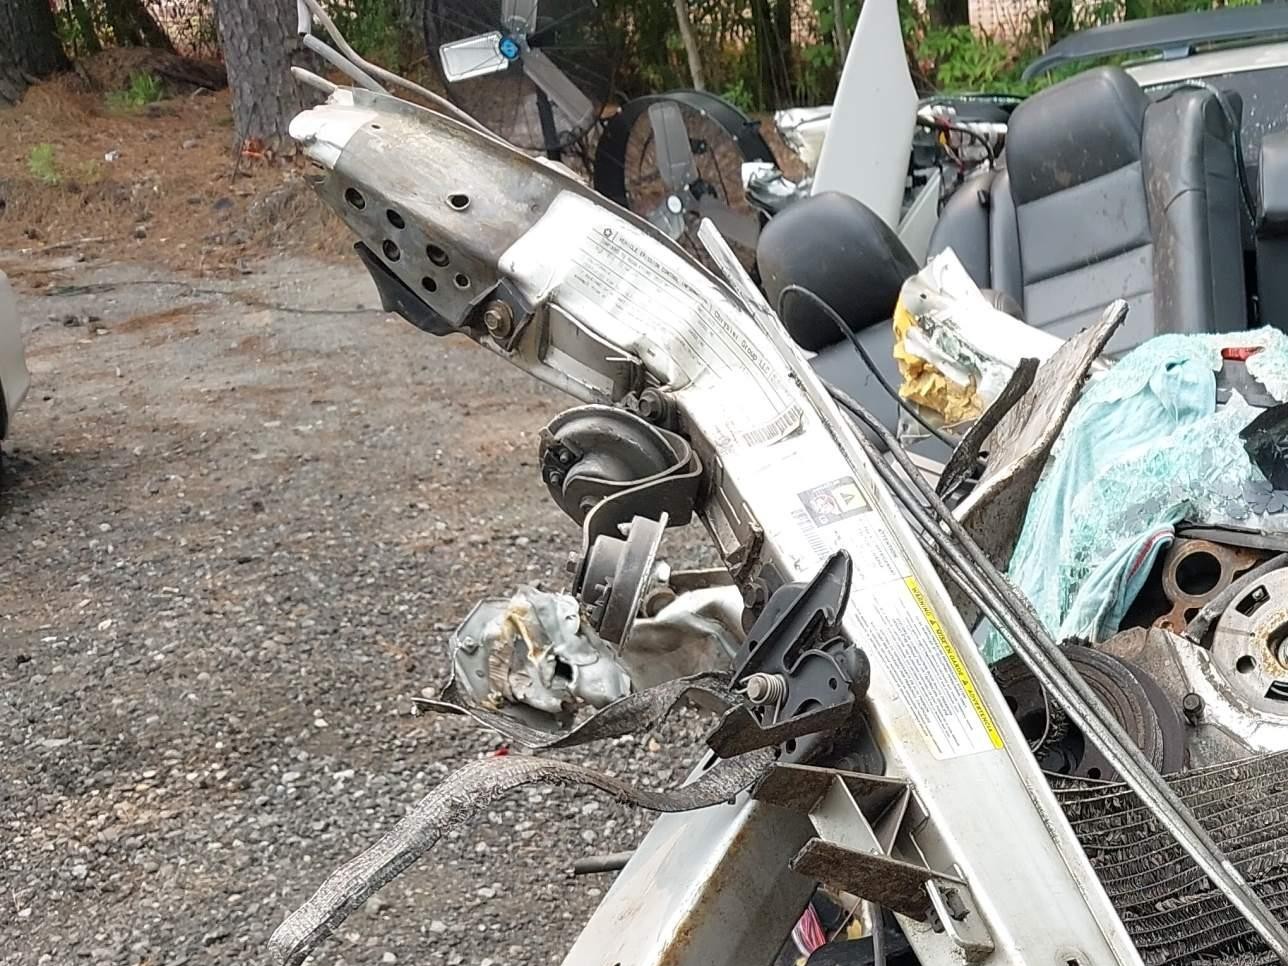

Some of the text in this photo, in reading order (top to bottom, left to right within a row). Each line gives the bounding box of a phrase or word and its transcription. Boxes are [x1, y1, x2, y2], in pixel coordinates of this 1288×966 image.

[711, 310, 740, 340] Chrysler
[738, 339, 759, 362] Group
[911, 586, 993, 732] WARNING MISE EN GARDE ADVERTENCIA
